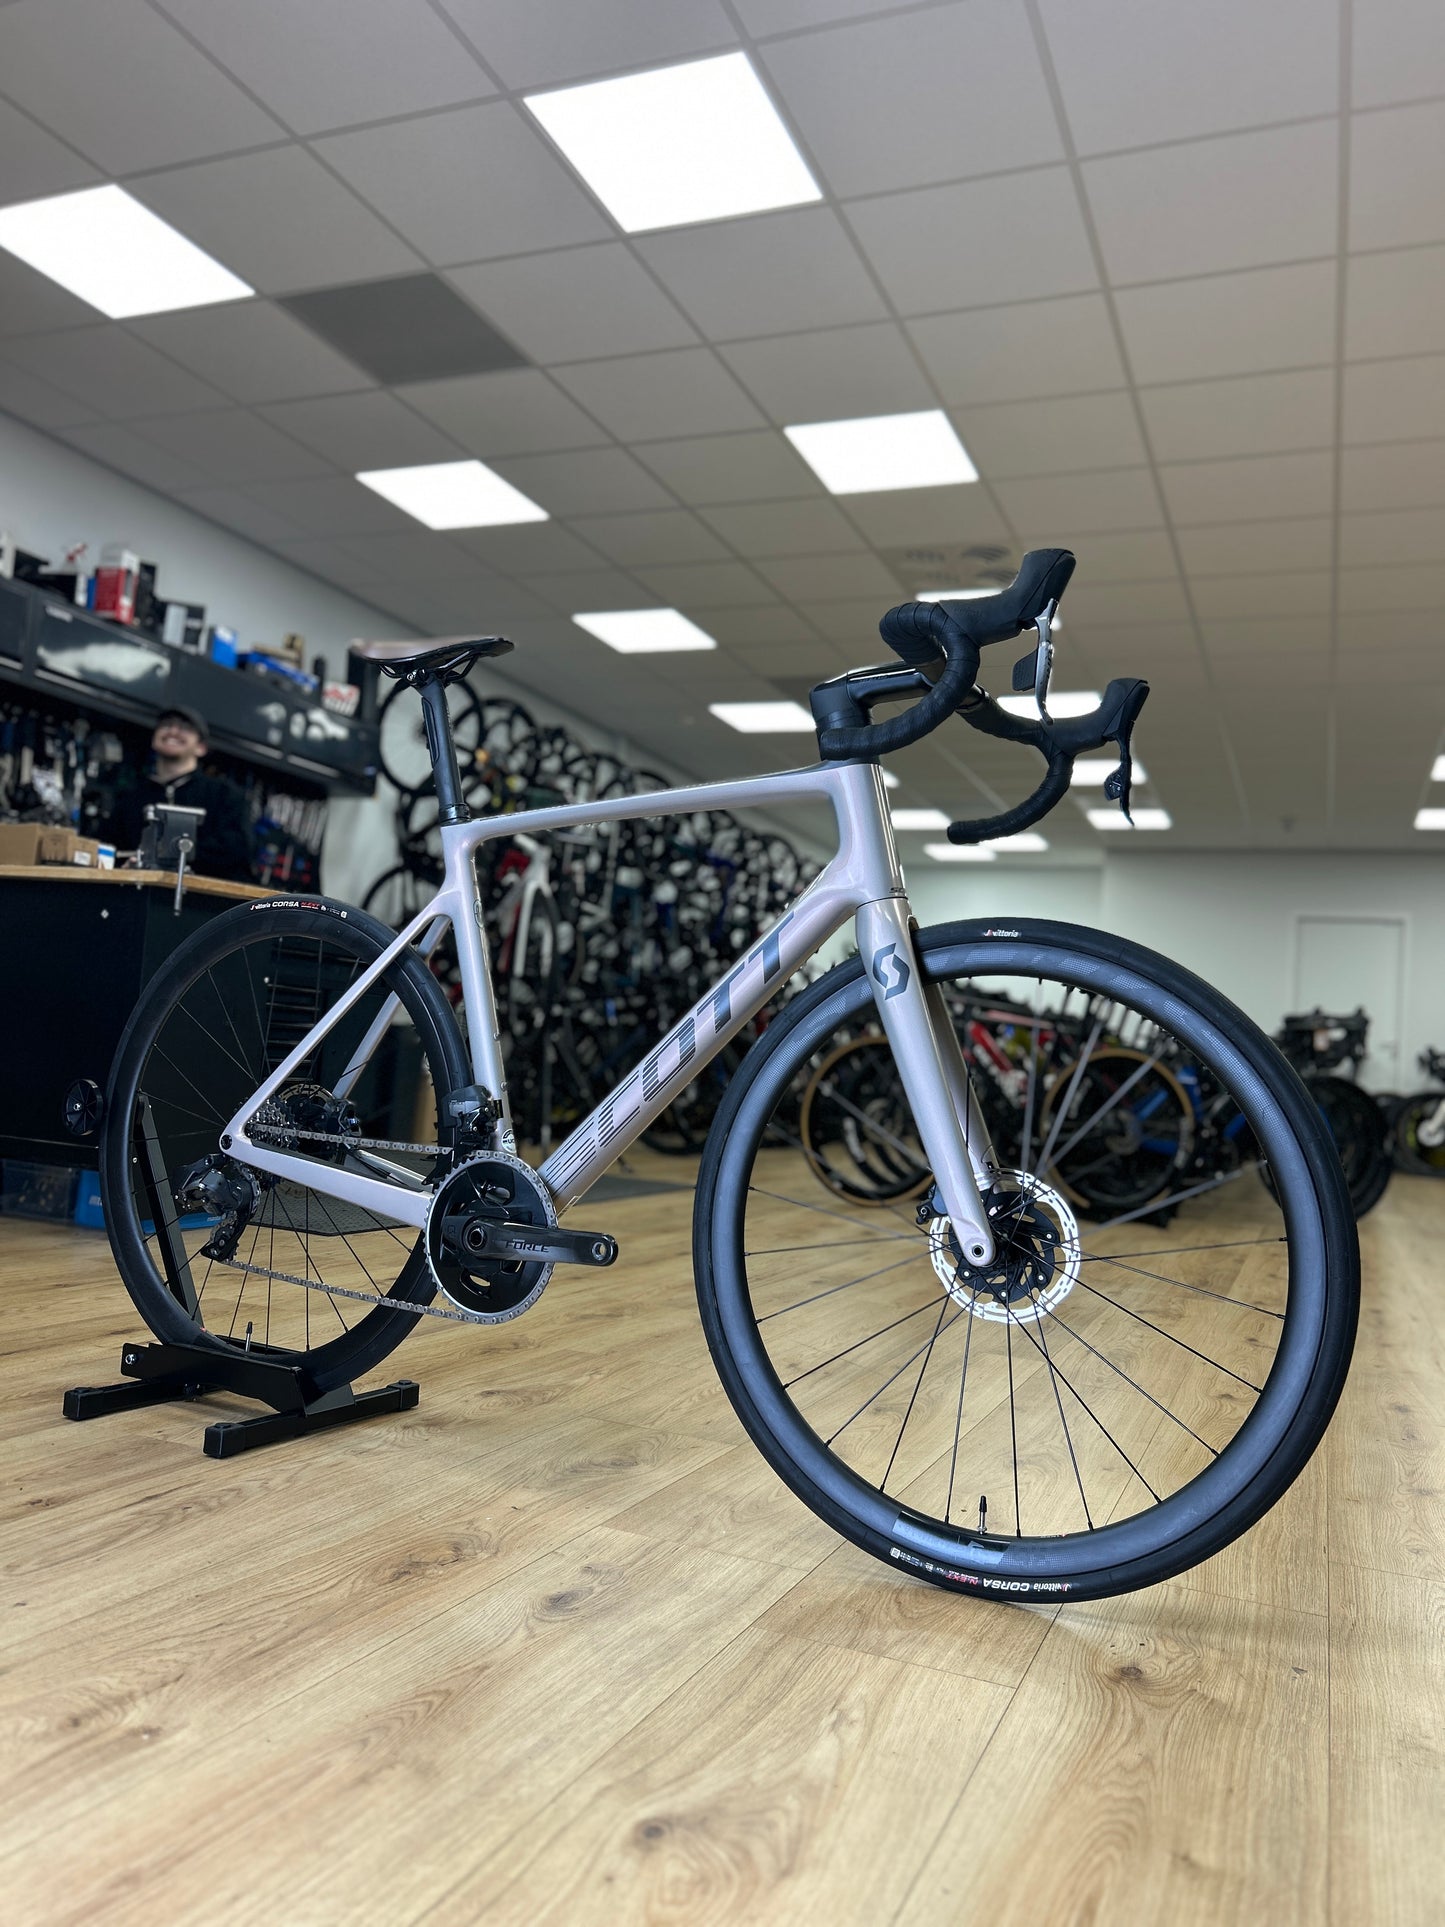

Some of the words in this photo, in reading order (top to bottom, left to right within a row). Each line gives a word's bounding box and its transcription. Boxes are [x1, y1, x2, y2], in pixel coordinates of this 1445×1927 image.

[991, 929, 1020, 938] vittoria
[546, 911, 794, 1196] SCOTT
[505, 1240, 549, 1253] FORCE
[983, 1578, 1030, 1592] CORSA
[1033, 1582, 1066, 1592] vittoria
